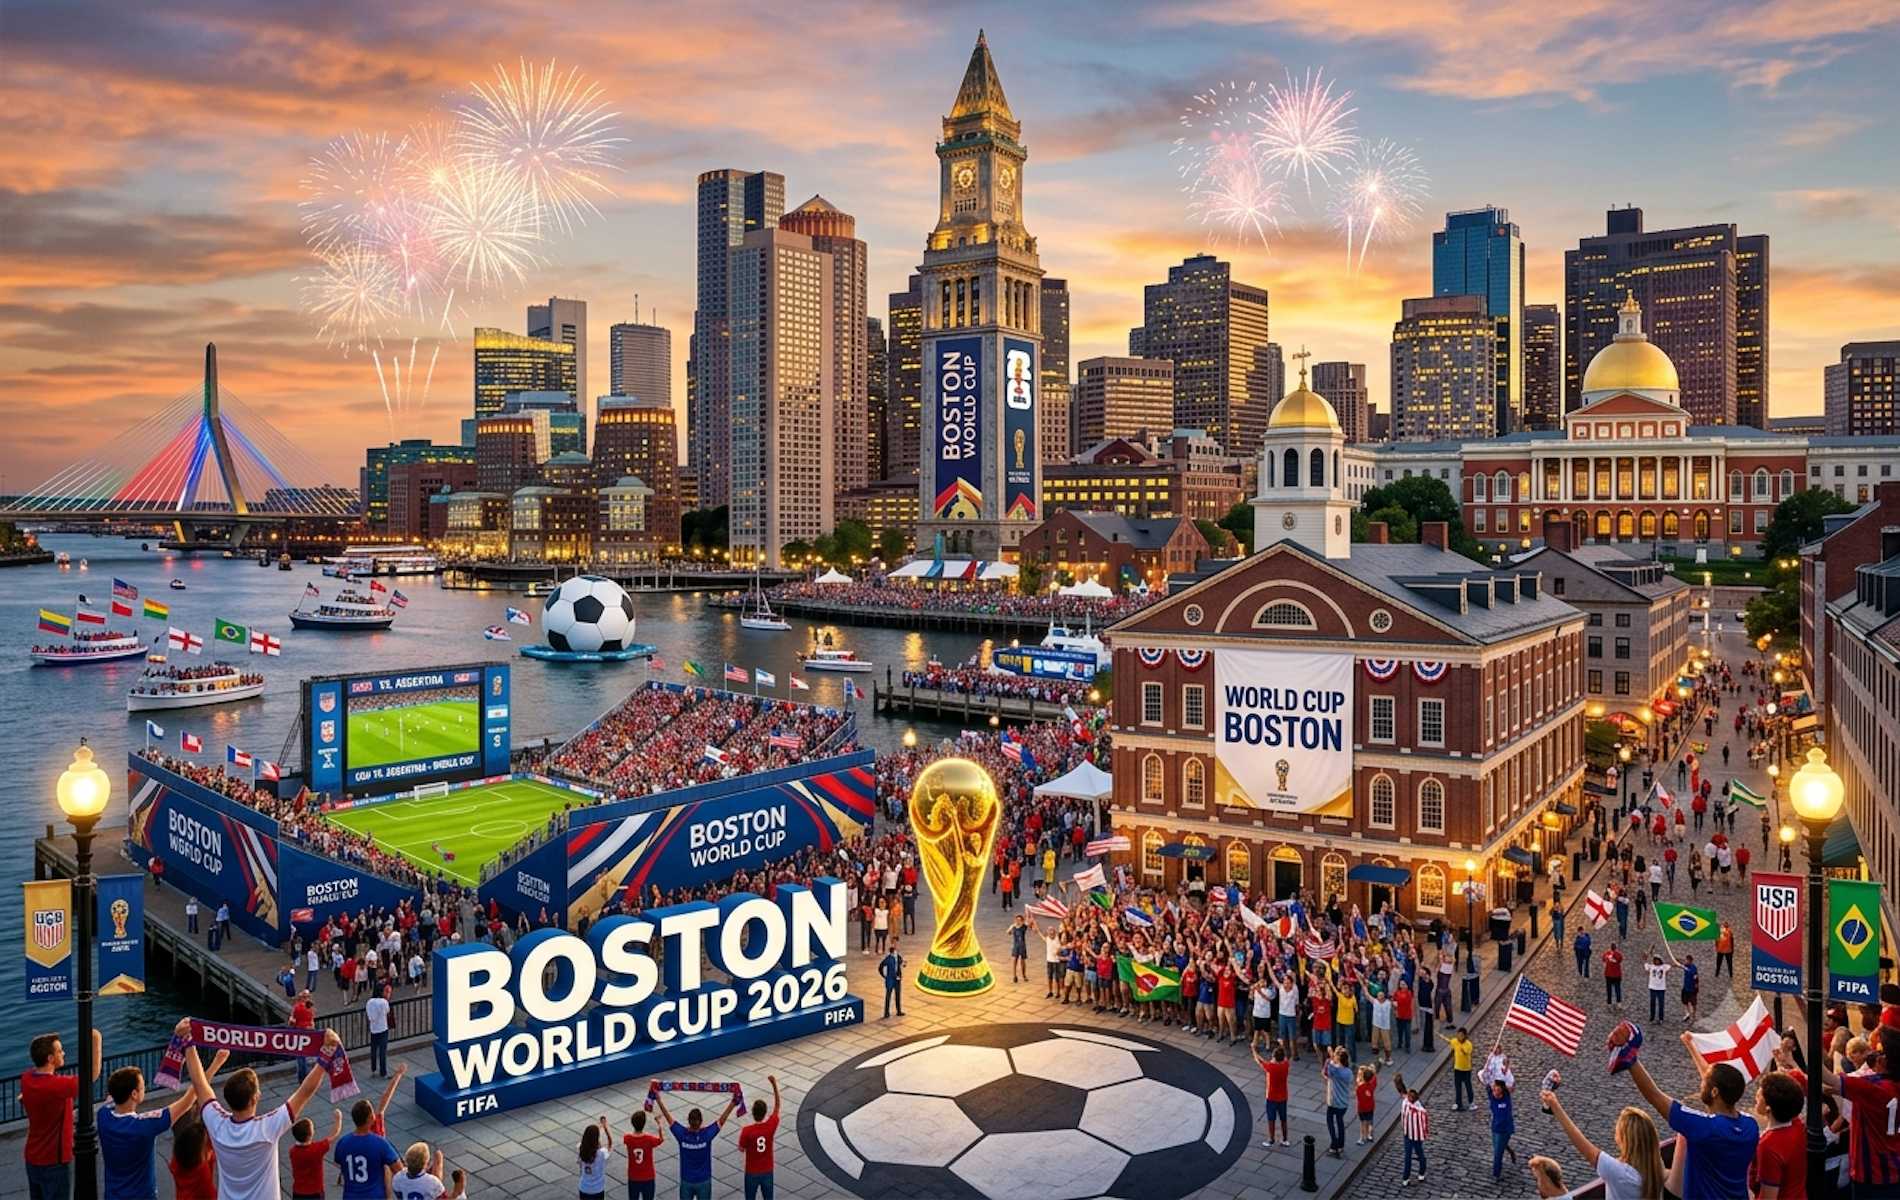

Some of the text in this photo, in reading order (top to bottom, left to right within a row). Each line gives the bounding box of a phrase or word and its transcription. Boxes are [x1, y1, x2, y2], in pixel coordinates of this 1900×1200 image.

[964, 355, 977, 390] CUP
[942, 352, 962, 460] BOSTON
[1225, 685, 1345, 713] WORLD CUP
[1225, 712, 1342, 751] BOSTON
[169, 808, 221, 857] BOSTON
[690, 804, 786, 849] BOSTON
[203, 853, 223, 876] CUP
[690, 830, 786, 868] WORLD CUP
[307, 877, 358, 896] BOSTON
[447, 882, 847, 1043] BOSTON
[202, 1025, 311, 1051] BORLD CUP
[448, 963, 848, 1089] WORLD CUP 2026
[457, 1094, 499, 1117] FIFA
[346, 1154, 368, 1183] 13
